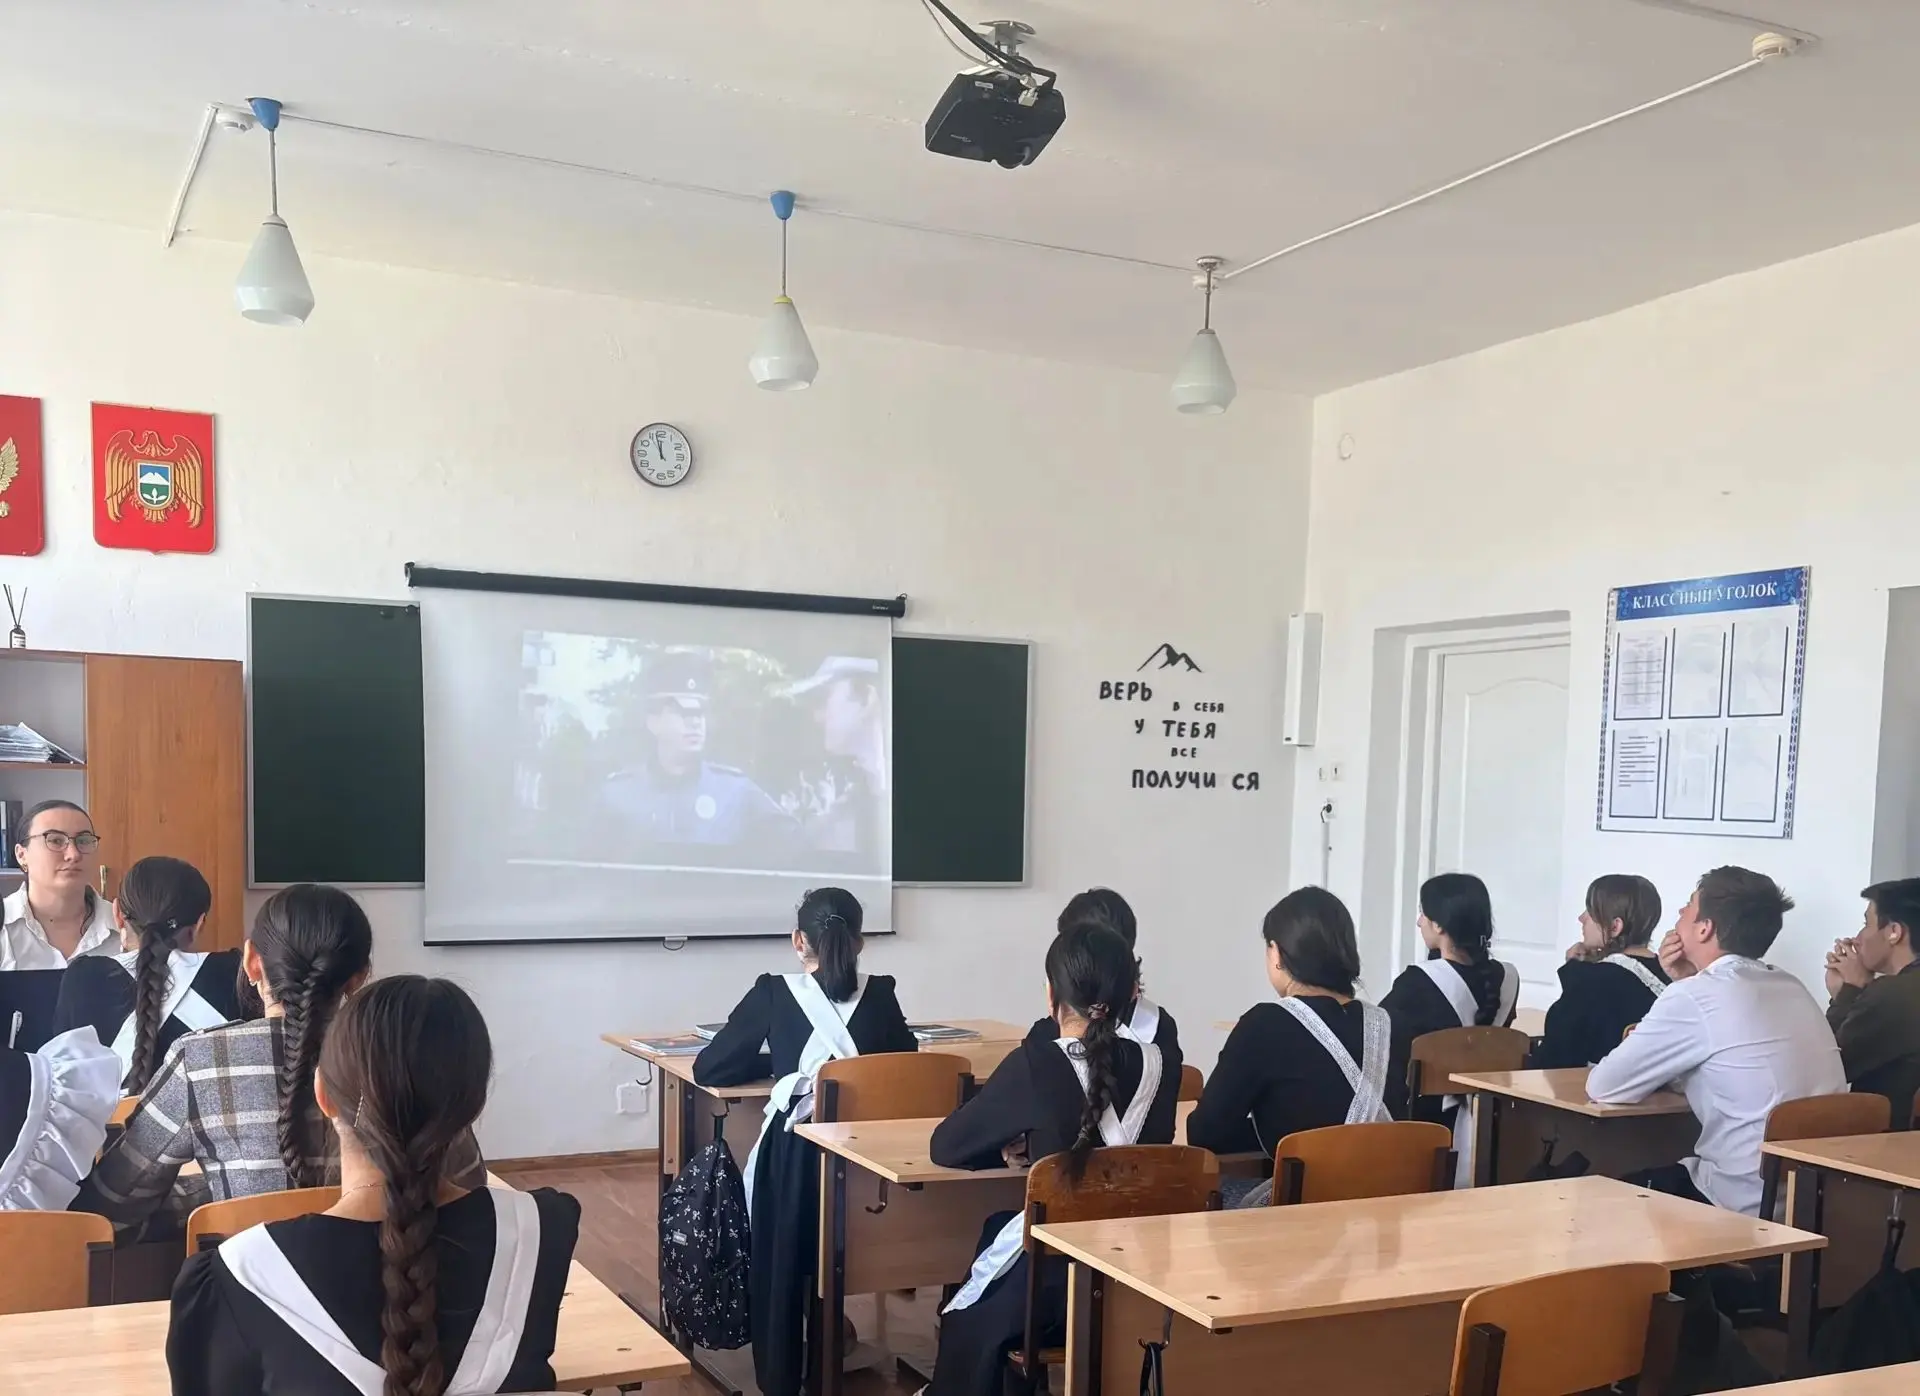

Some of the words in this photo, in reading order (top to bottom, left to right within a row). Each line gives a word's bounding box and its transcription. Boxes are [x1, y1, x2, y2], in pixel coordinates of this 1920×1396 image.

[640, 439, 650, 448] 10
[673, 442, 683, 451] 2
[637, 449, 648, 458] 9
[675, 453, 685, 462] 3
[640, 459, 650, 468] 8
[674, 463, 682, 471] 4
[647, 468, 656, 476] 7
[656, 472, 667, 481] 6
[666, 469, 676, 479] 5
[1633, 587, 1712, 609] КЛАССНЫЙ
[1716, 582, 1778, 601] УГОЛОК
[1099, 680, 1153, 702] ВЕРЬ
[1172, 701, 1181, 712] В
[1193, 702, 1225, 714] СЕБЯ
[1134, 718, 1145, 735] У
[1161, 719, 1217, 740] ТЕБЯ
[1170, 747, 1197, 759] ВСЕ
